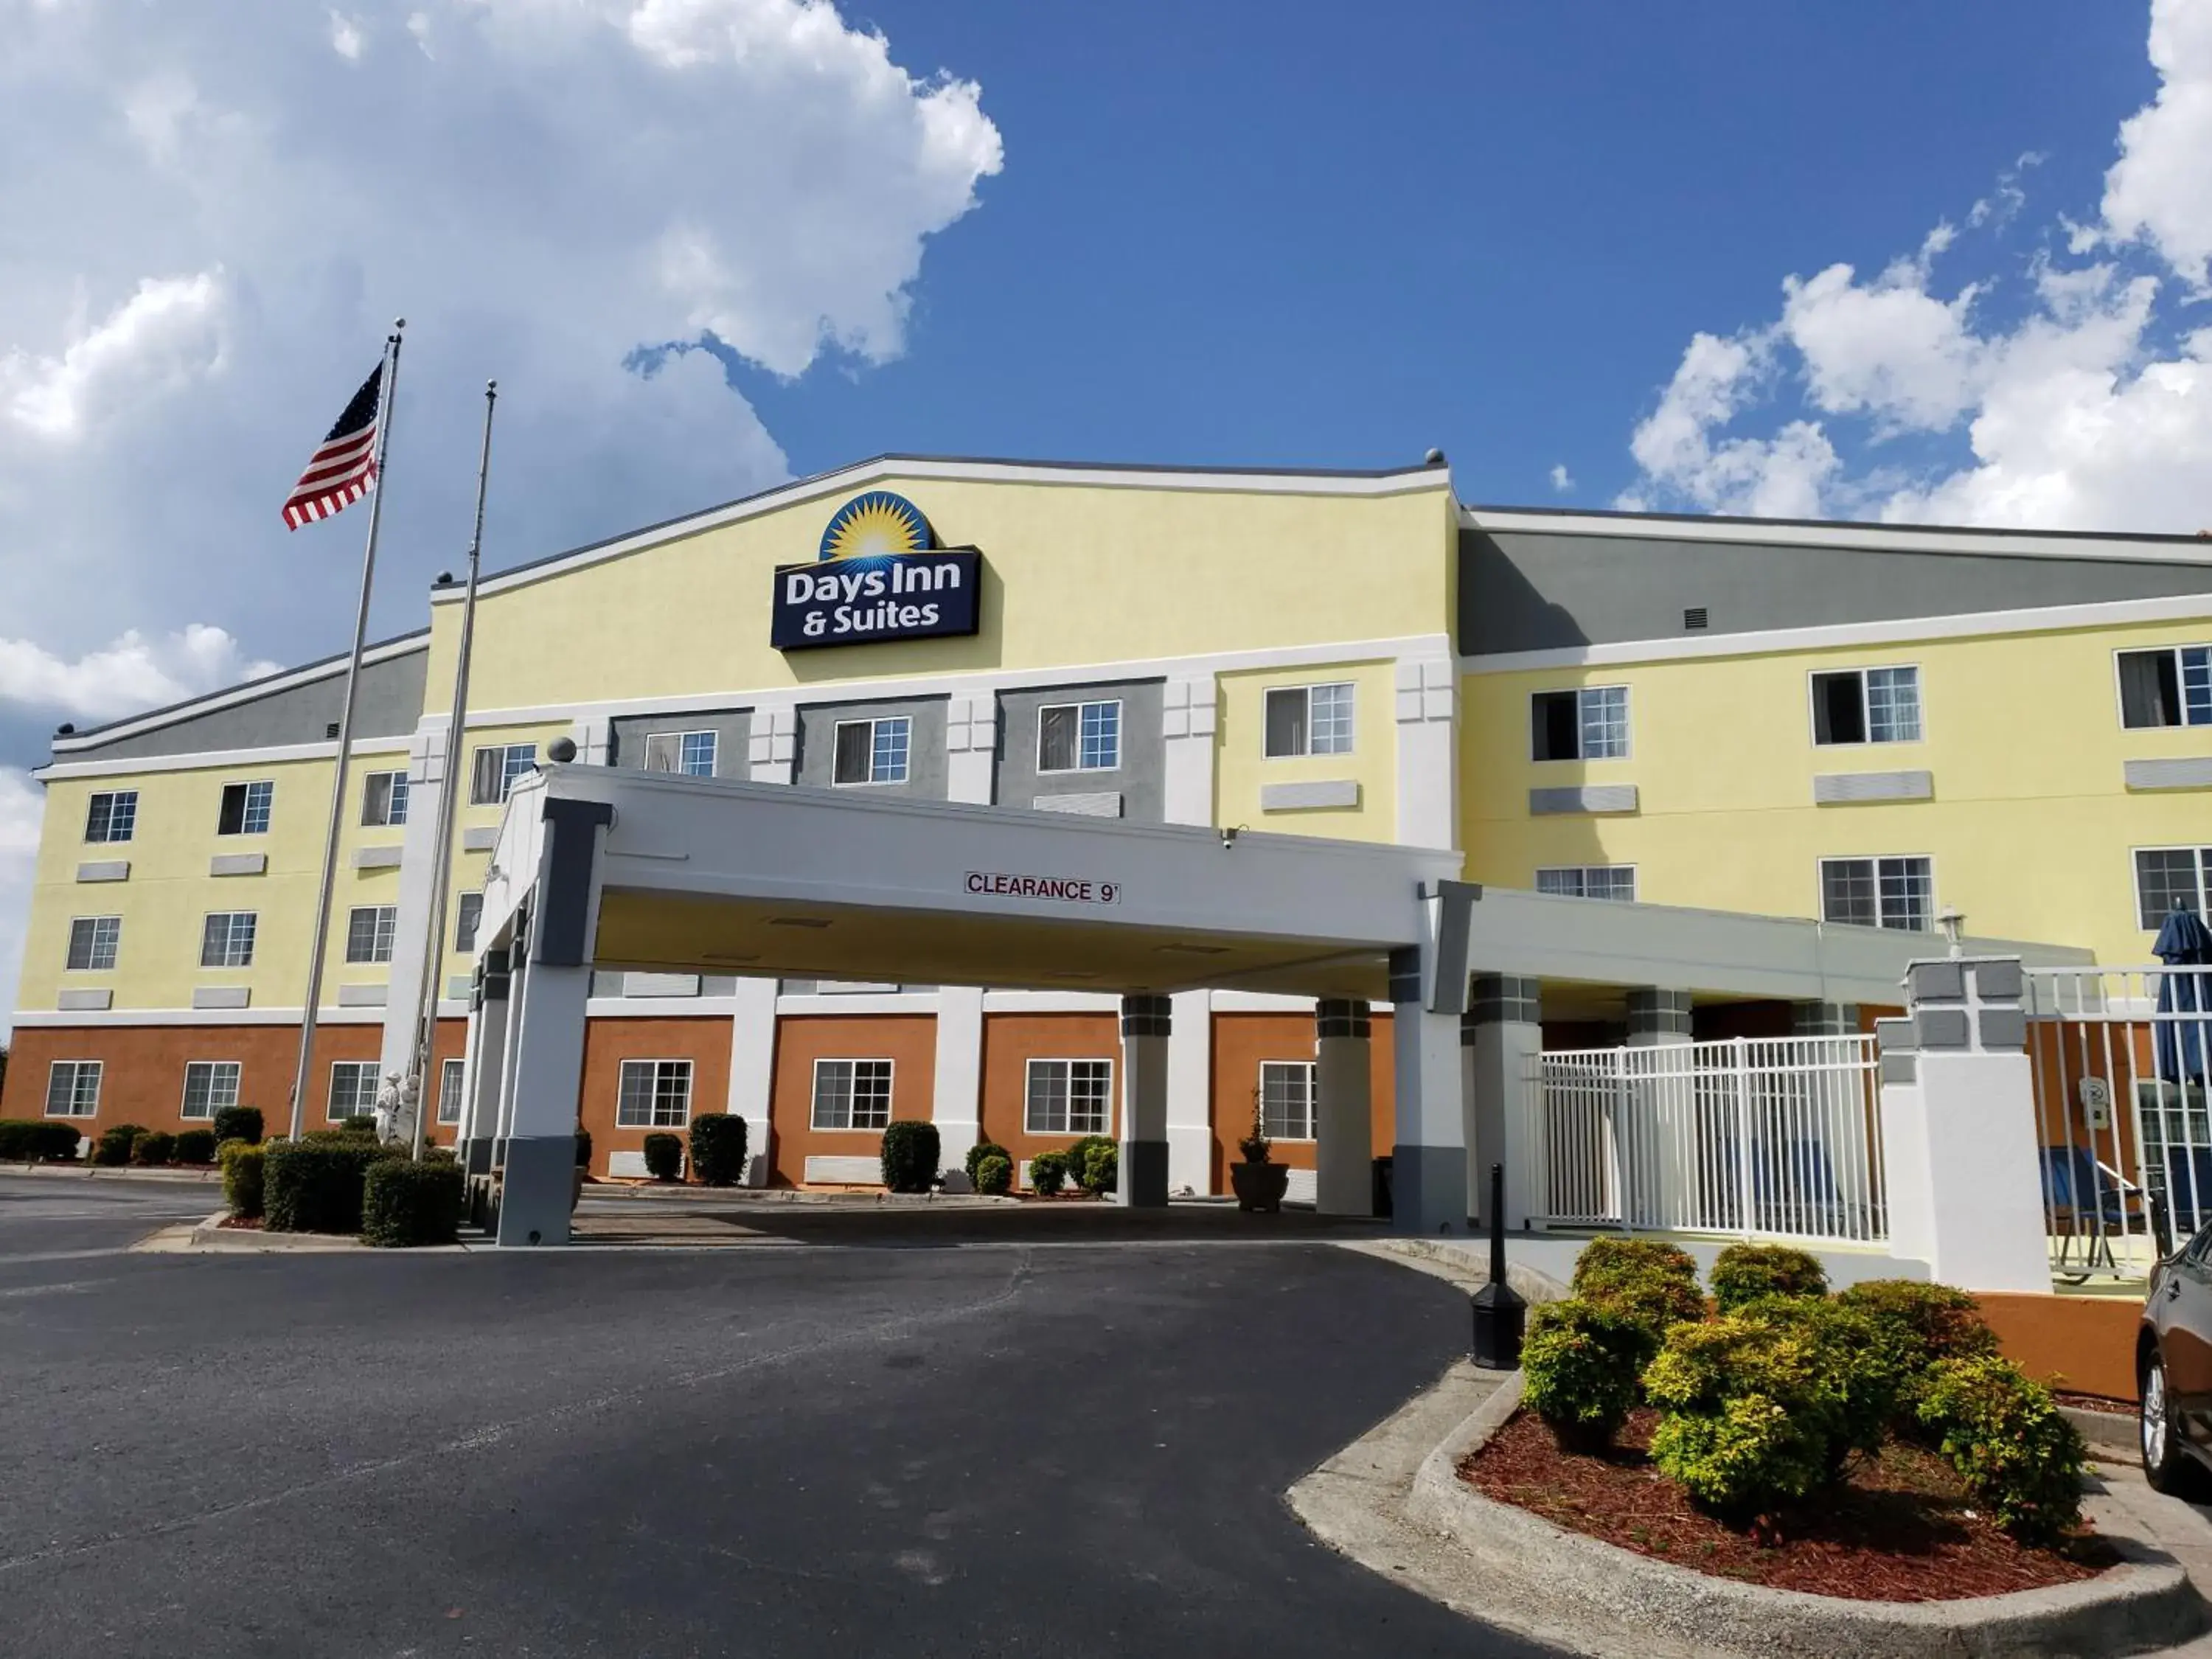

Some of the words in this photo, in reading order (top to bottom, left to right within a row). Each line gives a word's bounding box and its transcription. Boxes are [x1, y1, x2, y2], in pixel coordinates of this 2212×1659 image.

[786, 570, 886, 605] Days
[893, 563, 960, 594] Inn
[803, 611, 827, 636] &
[832, 600, 939, 633] Suites
[967, 874, 1092, 900] CLEARANCE
[1100, 884, 1119, 902] 9'
